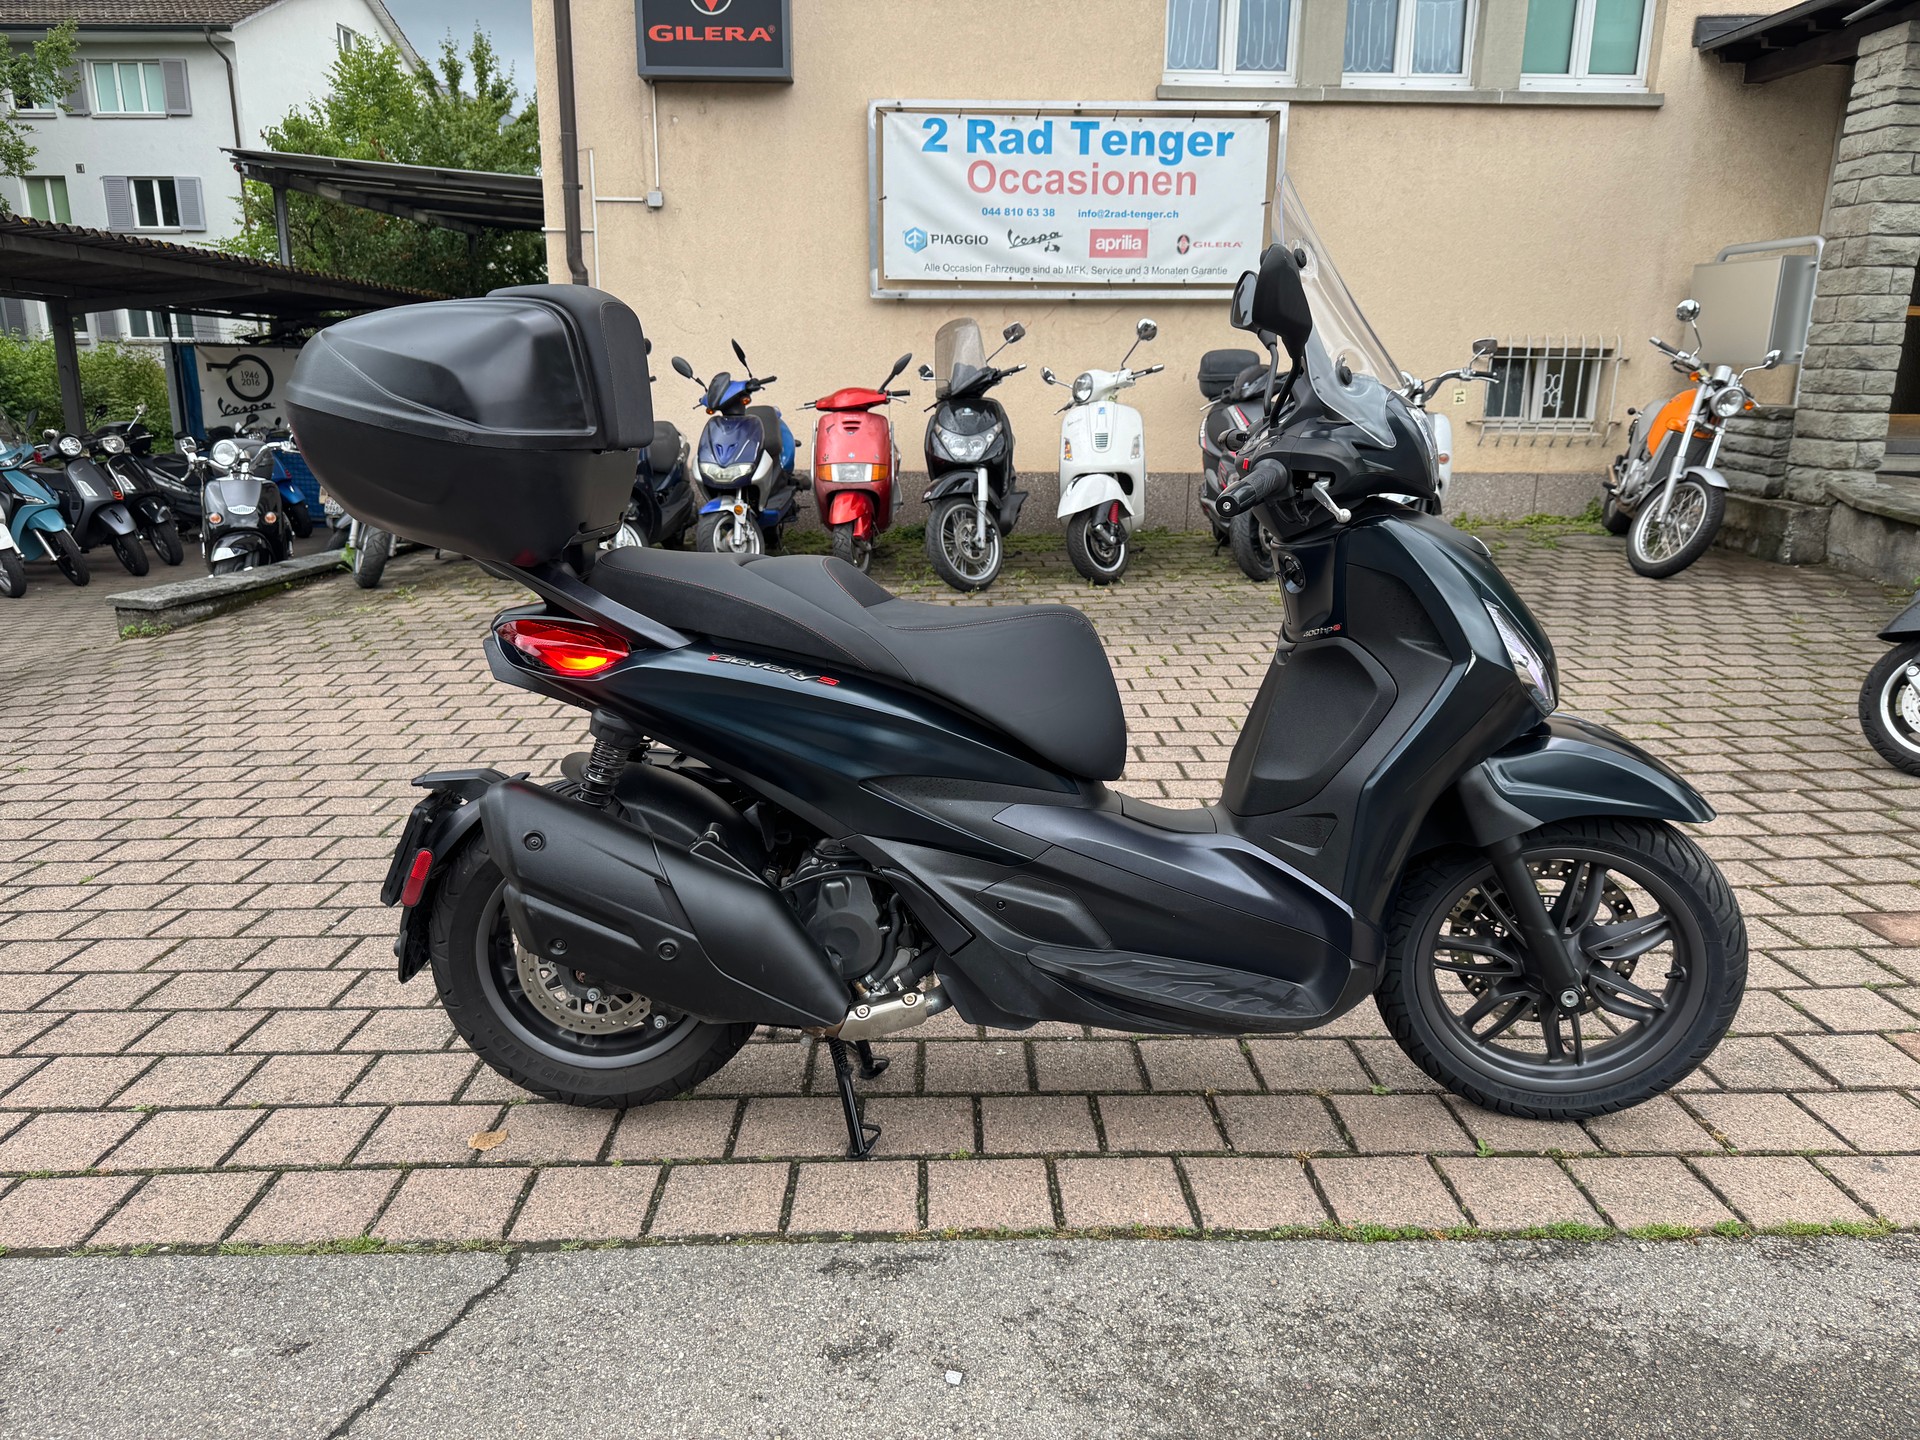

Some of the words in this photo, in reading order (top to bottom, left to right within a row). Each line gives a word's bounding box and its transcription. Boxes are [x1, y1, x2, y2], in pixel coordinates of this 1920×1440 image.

[921, 117, 948, 153] 2
[966, 118, 1053, 155] Rad
[1070, 120, 1235, 166] Tenger
[966, 159, 1197, 196] Occasionen
[981, 206, 1001, 217] 044
[1004, 207, 1024, 217] 810
[1026, 207, 1040, 217] 63
[1042, 207, 1056, 218] 38
[1077, 208, 1180, 221] info@2rad-tenger.ch
[930, 233, 989, 246] PIAGGIO
[1007, 228, 1064, 250] Vespa
[1095, 233, 1142, 253] aprilia
[1192, 240, 1242, 249] GILERA
[923, 262, 941, 273] Alle
[942, 262, 983, 274] Occasion
[984, 263, 1031, 276] Fahrzeuge
[1032, 264, 1051, 275] sind
[1052, 265, 1064, 275] ab
[1066, 265, 1089, 276] MFK,
[1090, 265, 1123, 275] Service
[1125, 265, 1142, 275] und
[1143, 266, 1149, 275] 3
[1151, 265, 1192, 276] Monaten
[1194, 265, 1228, 276] Garantie
[240, 370, 260, 379] 1946
[241, 378, 261, 387] 2016
[217, 396, 277, 418] Vespa
